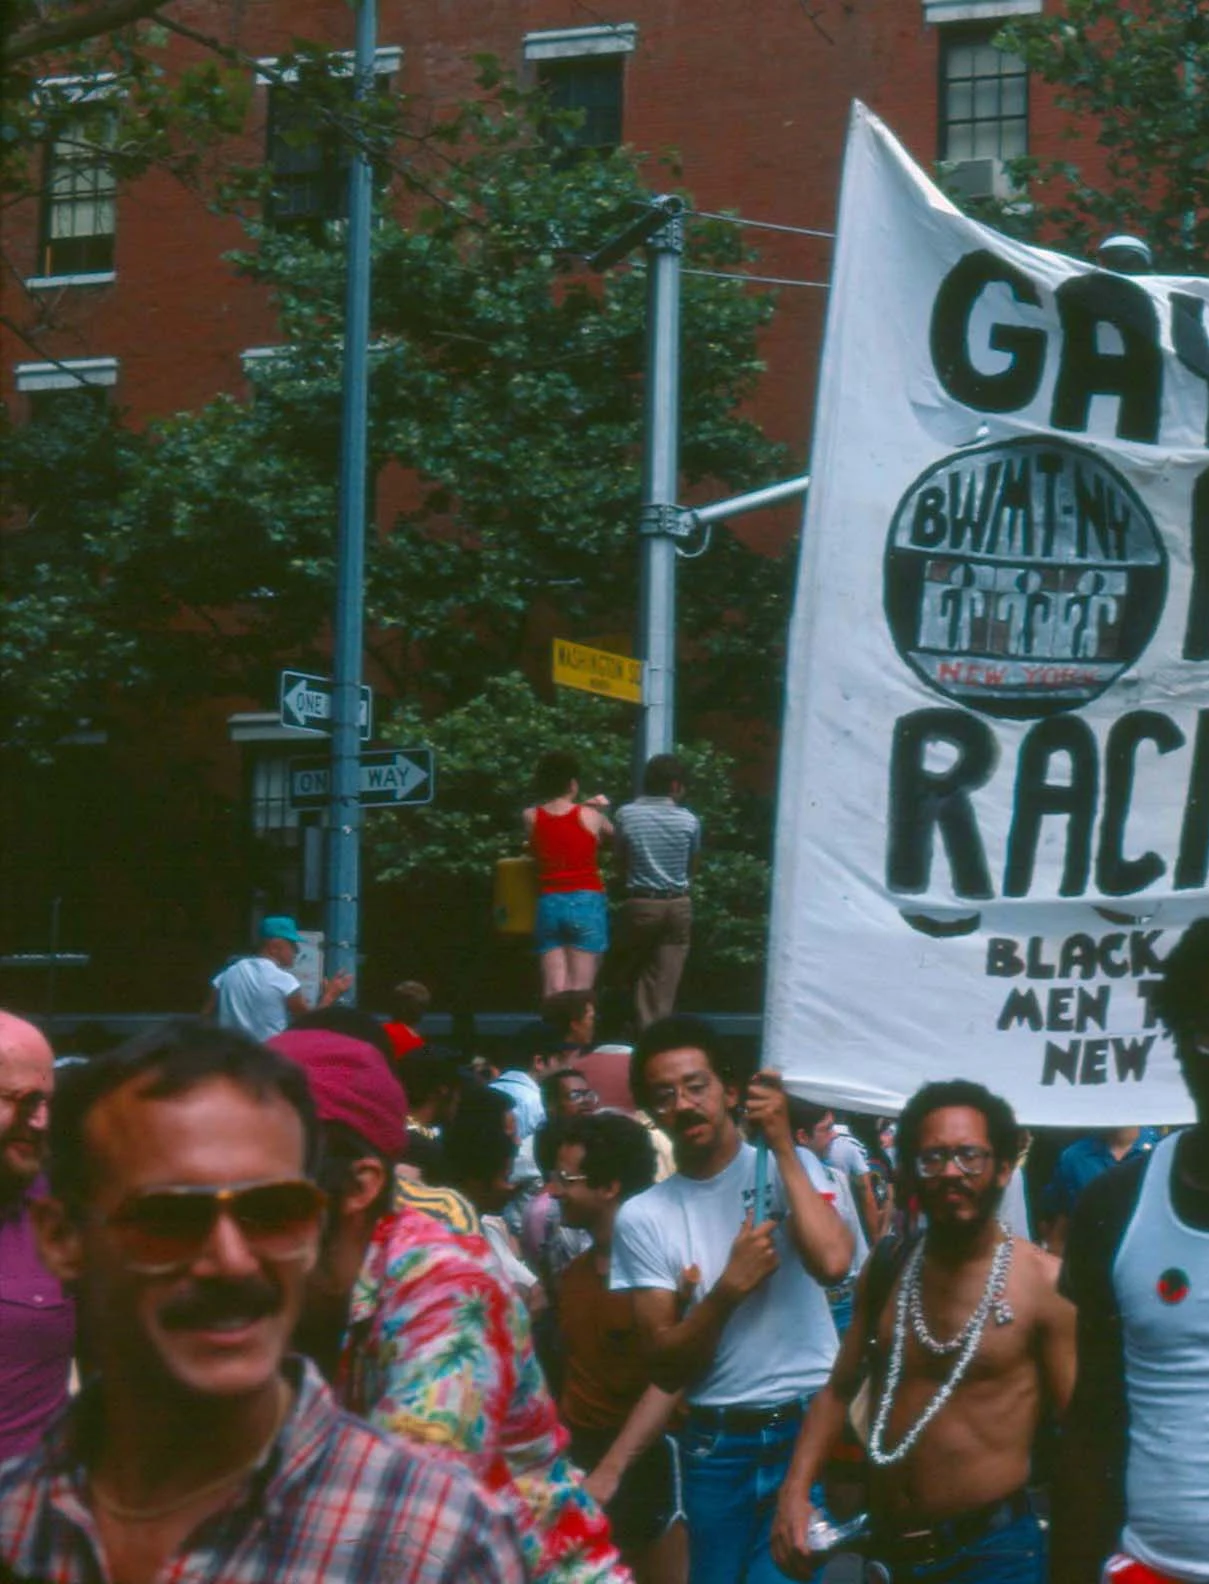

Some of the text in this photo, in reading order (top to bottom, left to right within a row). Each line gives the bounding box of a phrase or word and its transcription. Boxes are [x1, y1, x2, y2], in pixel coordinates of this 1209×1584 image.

[938, 662, 1099, 686] NEW YORK
[296, 691, 322, 715] ONE
[300, 766, 410, 793] ON WAY
[986, 929, 1166, 980] BLACK
[997, 984, 1111, 1034] MEN
[1041, 1034, 1158, 1086] NEW
